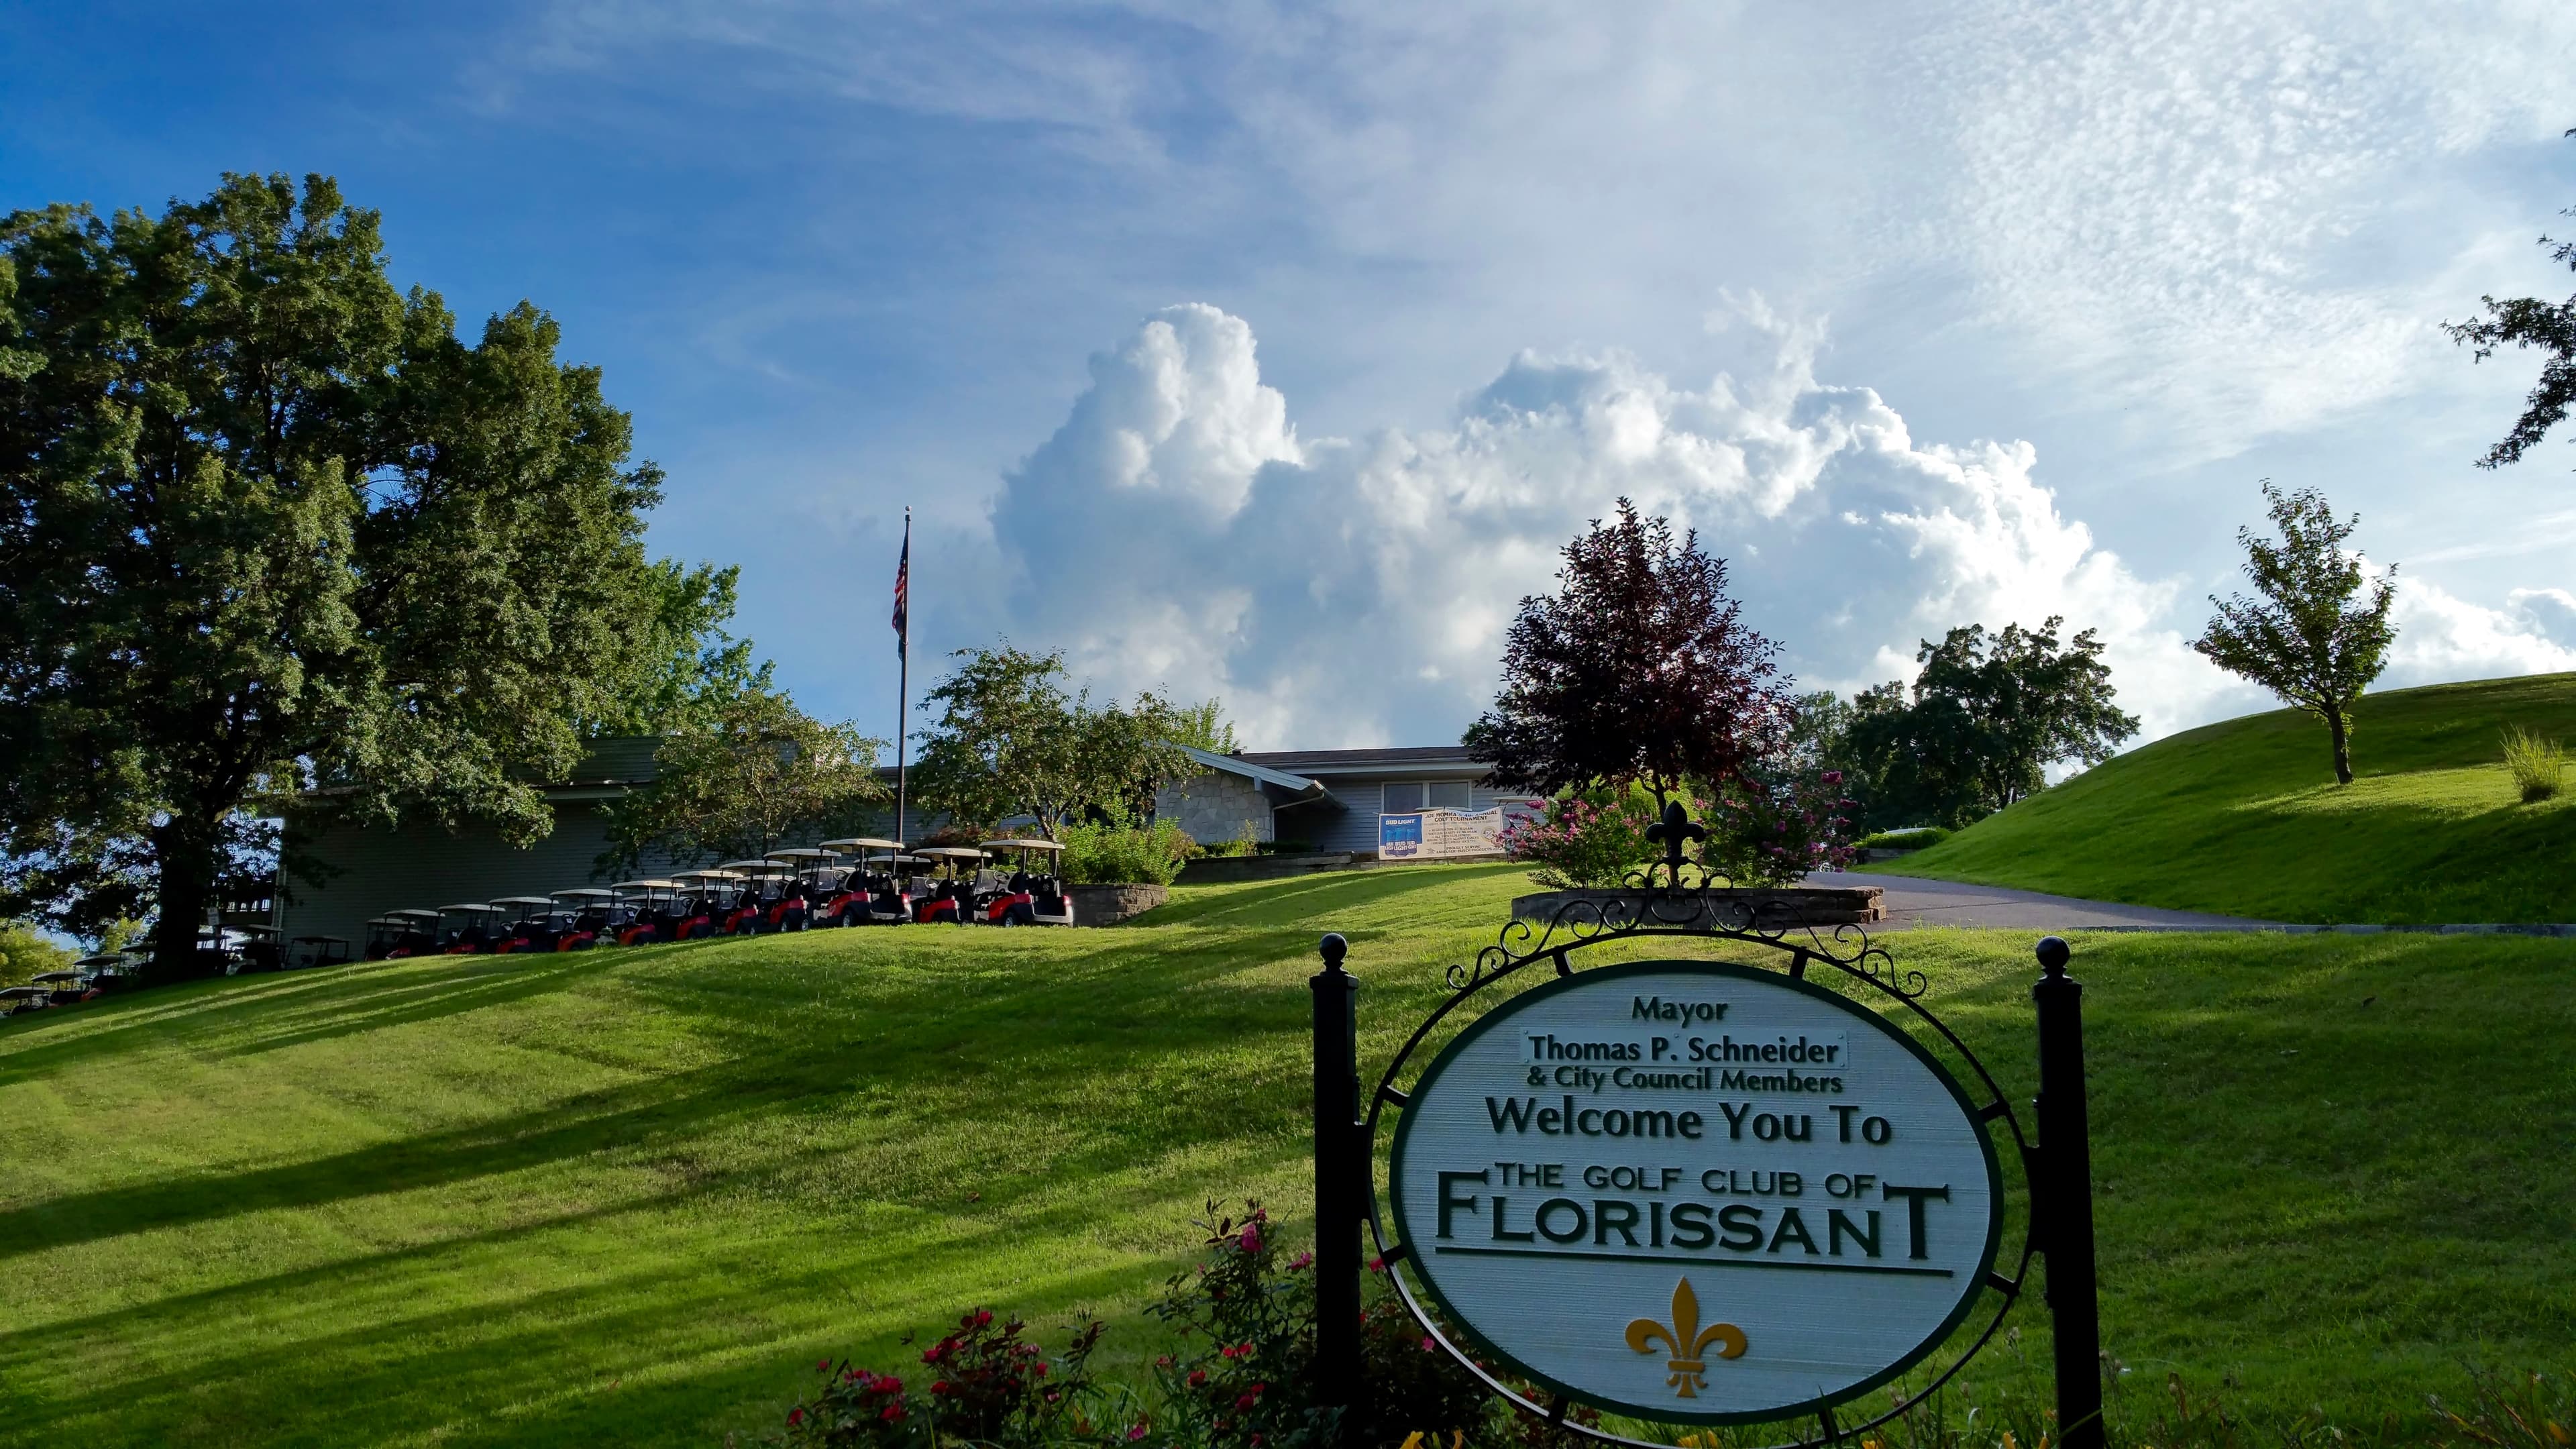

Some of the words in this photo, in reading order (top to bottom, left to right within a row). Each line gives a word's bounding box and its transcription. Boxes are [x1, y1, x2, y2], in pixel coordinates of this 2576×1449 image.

[1631, 996, 1729, 1028] Mayor
[1527, 1034, 1641, 1061] Thomas
[1651, 1036, 1678, 1061] P.
[1688, 1034, 1839, 1063] Schneider
[1526, 1065, 1546, 1086] &
[1554, 1065, 1607, 1093] City
[1613, 1066, 1711, 1090] Council
[1720, 1069, 1843, 1093] Members
[1485, 1095, 1703, 1140] Welcome
[1718, 1102, 1812, 1141] You
[1829, 1105, 1893, 1145] To
[1495, 1161, 1564, 1187] THE
[1583, 1165, 1682, 1192] GOLF
[1701, 1169, 1803, 1197] CLUB
[1825, 1173, 1876, 1199] OF
[1436, 1168, 1949, 1260] FLORISSANT
